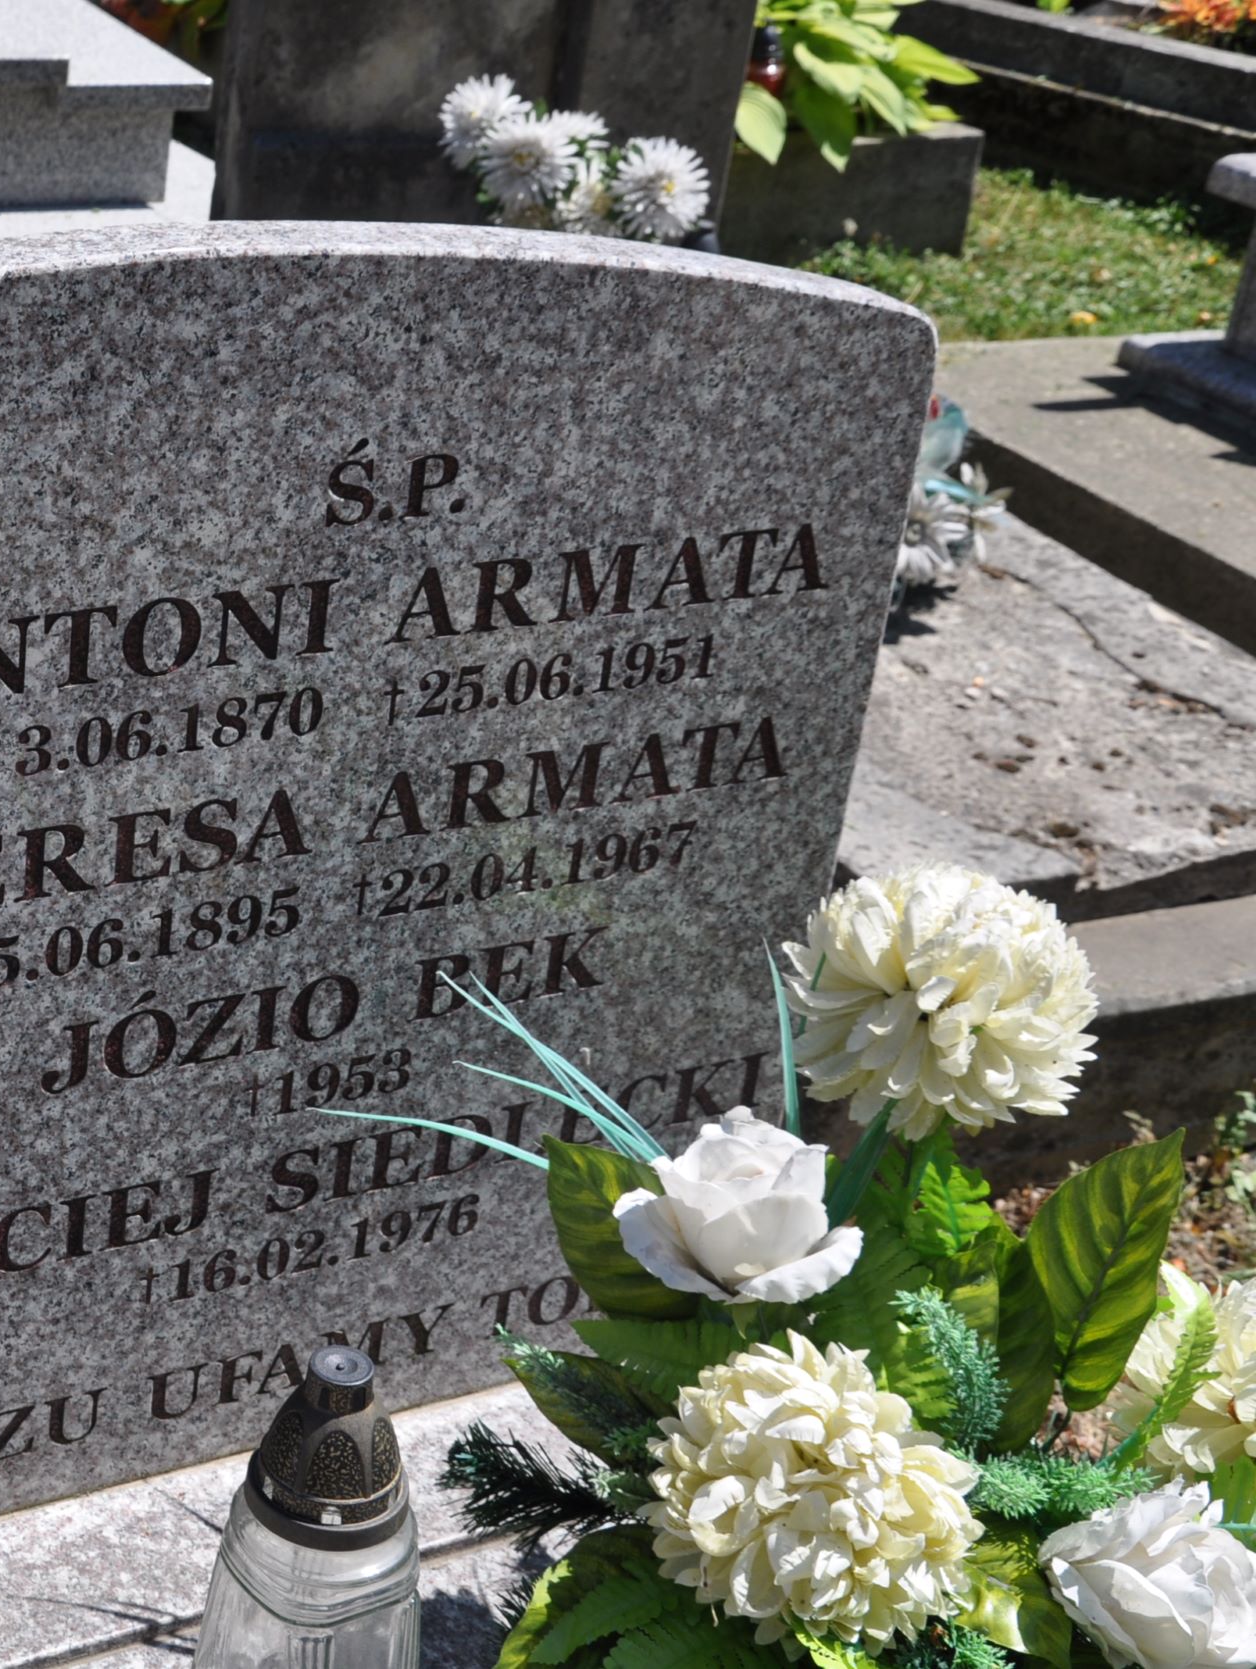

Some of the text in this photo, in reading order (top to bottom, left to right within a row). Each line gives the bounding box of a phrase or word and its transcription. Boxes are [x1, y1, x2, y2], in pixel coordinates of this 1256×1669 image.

[384, 523, 829, 645] ARMATA
[15, 633, 714, 777] 3.06.1870 25.06.1951
[357, 715, 788, 845] ARMATA
[378, 820, 697, 918] 22.04.1967
[41, 926, 609, 1095] JÓZIO BEK
